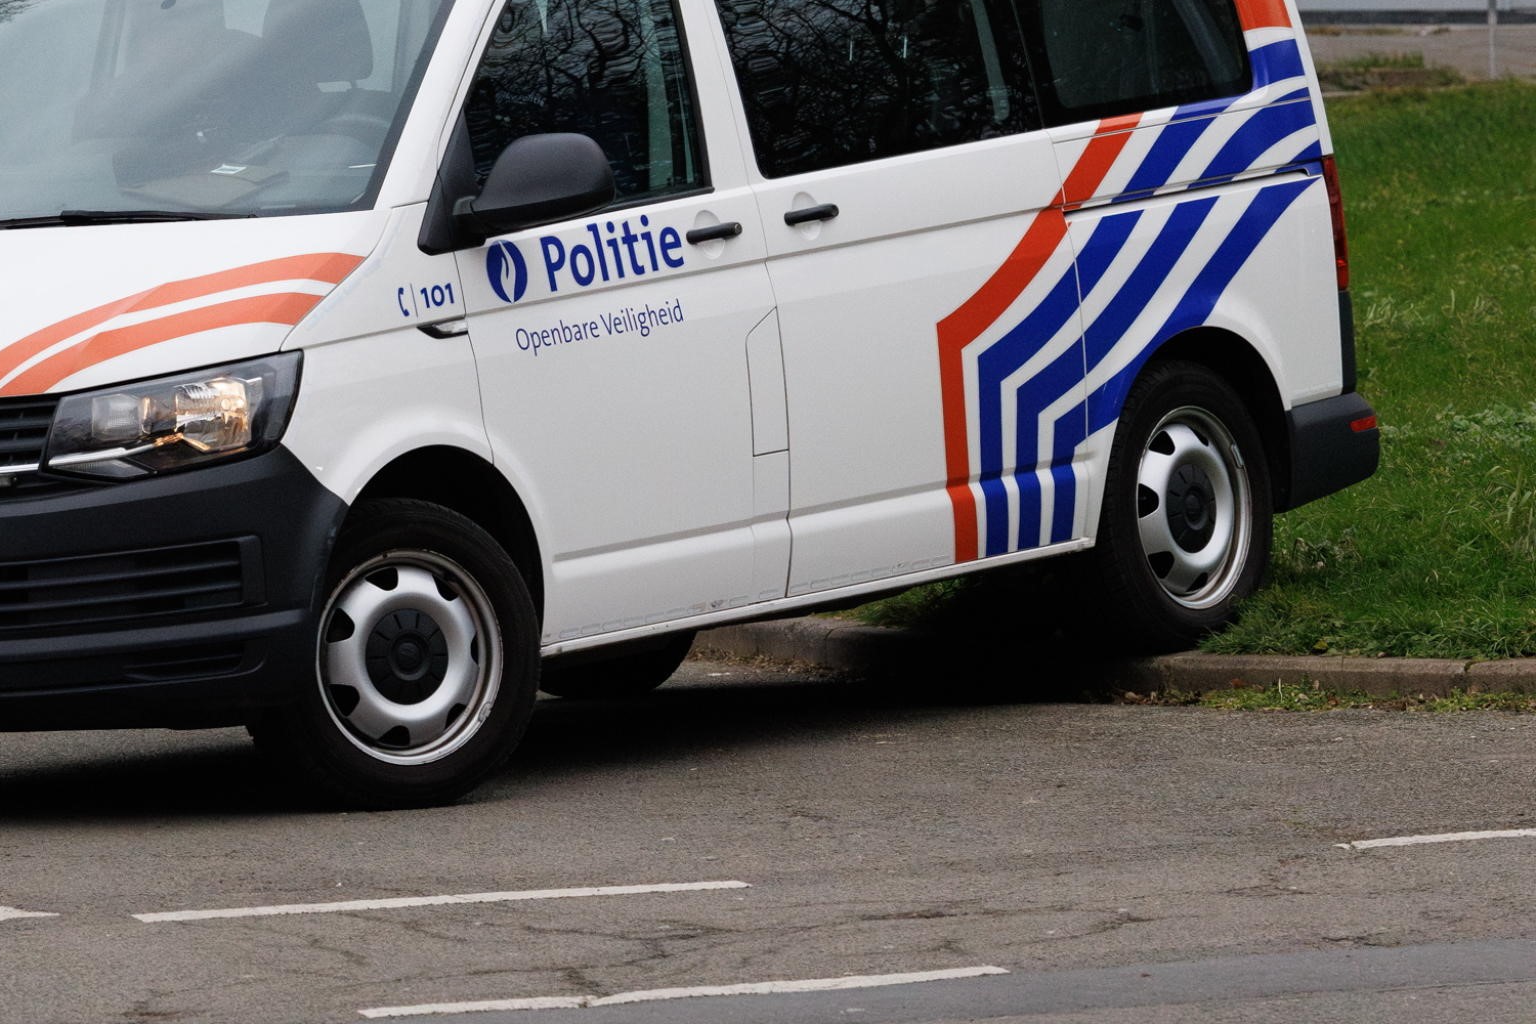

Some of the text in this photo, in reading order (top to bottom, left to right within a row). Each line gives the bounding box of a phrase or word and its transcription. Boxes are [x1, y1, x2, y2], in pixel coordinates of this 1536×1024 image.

[540, 214, 685, 292] Politie
[419, 282, 455, 309] 101
[515, 298, 685, 356] Openbare Veiligheid
